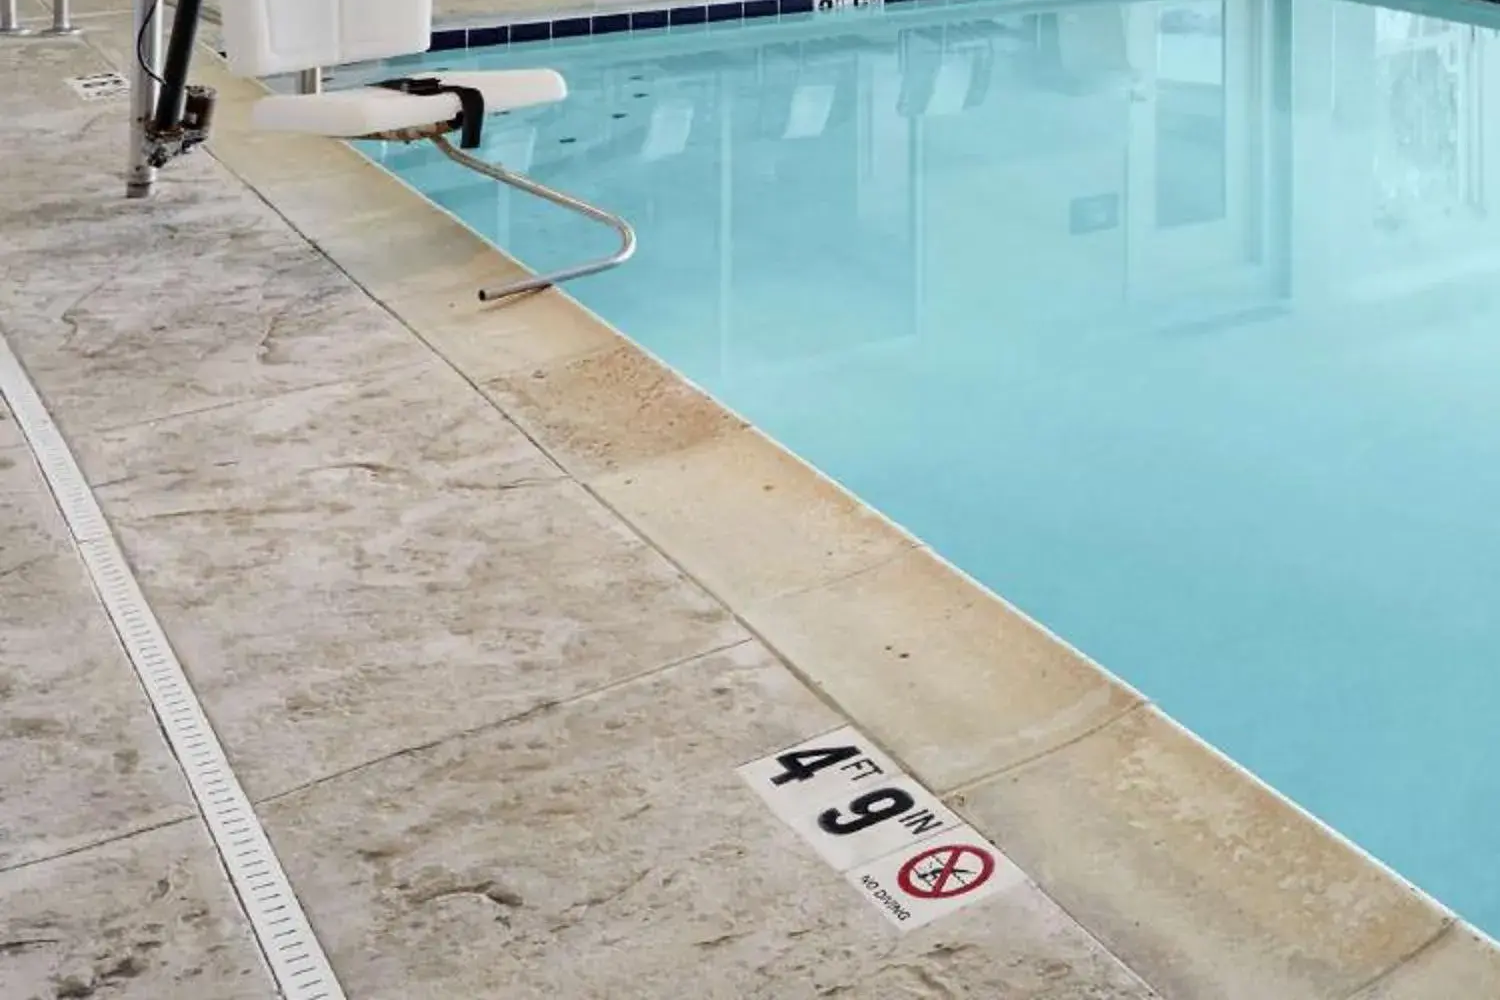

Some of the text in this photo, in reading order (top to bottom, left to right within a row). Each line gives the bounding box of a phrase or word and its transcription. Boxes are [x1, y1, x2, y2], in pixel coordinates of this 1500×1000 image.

[770, 746, 943, 835] 4 FT 9 IN
[861, 874, 911, 921] NO DIVING
